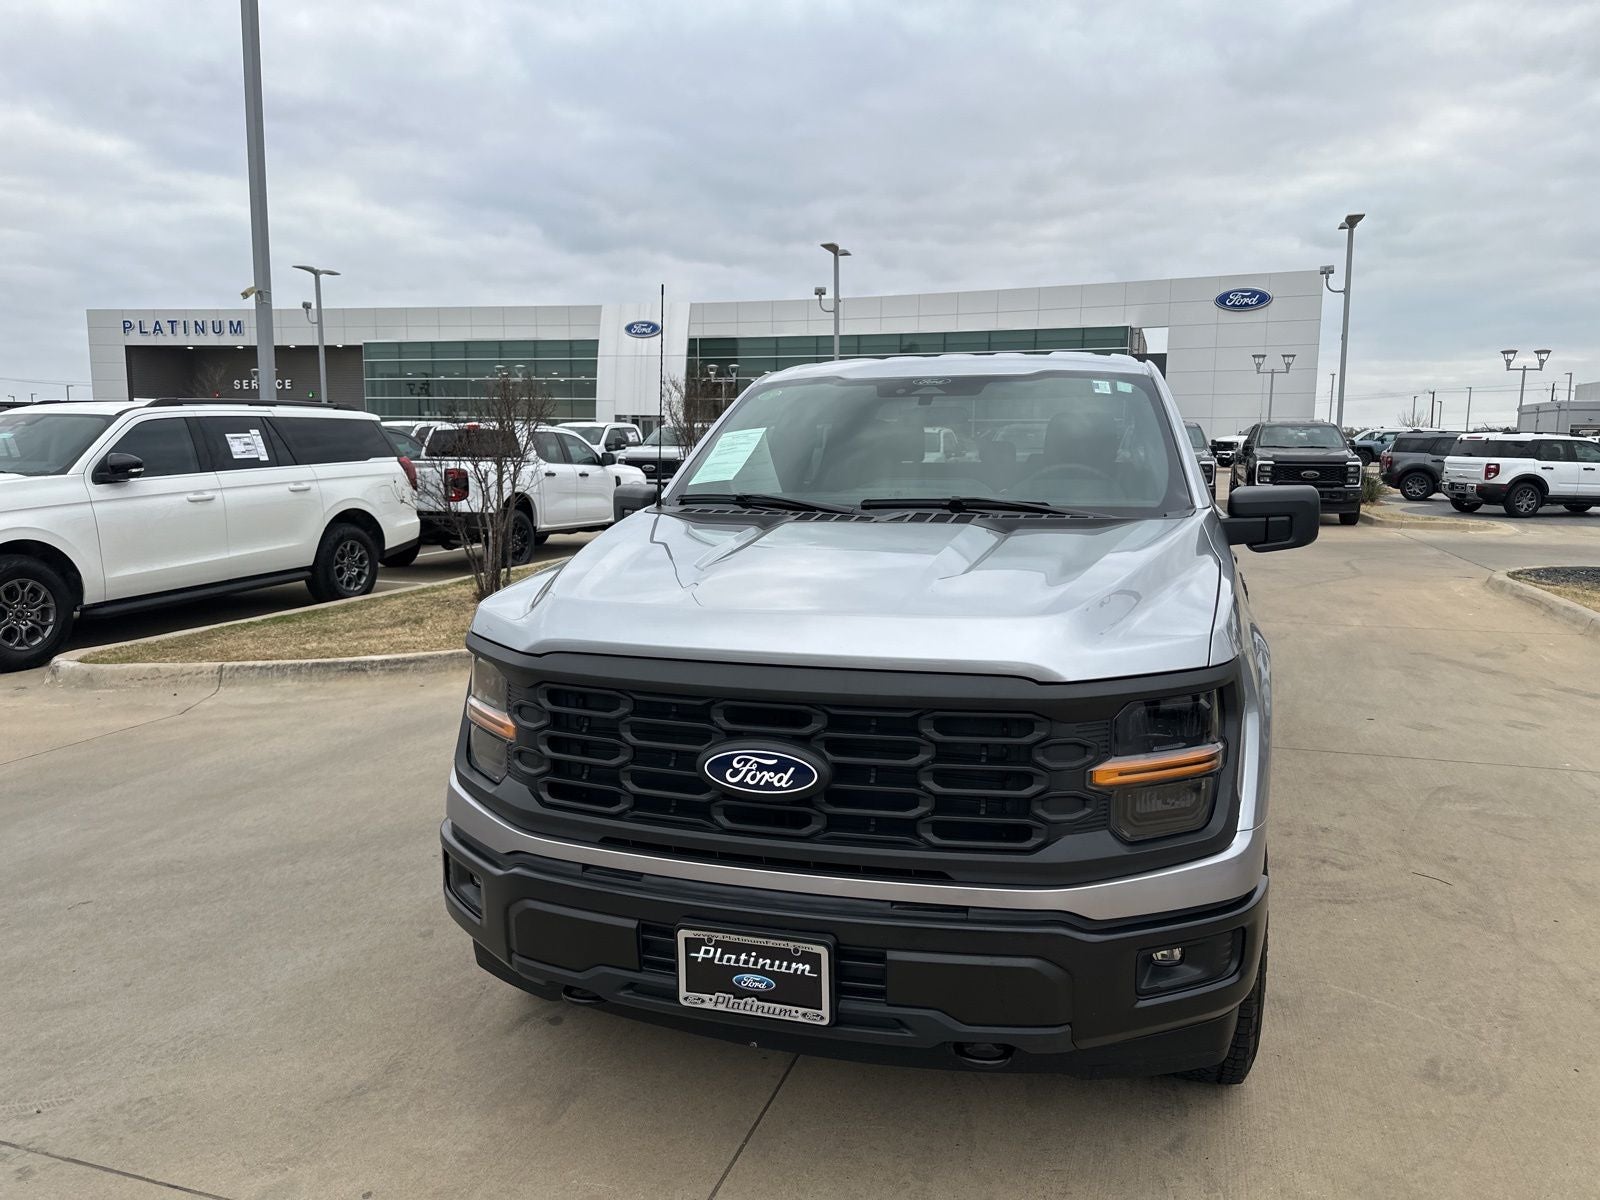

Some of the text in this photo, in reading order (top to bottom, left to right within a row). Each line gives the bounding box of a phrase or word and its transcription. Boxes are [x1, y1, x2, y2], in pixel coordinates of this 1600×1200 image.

[1226, 291, 1259, 305] Ford
[122, 320, 243, 335] PLATINUM
[631, 323, 653, 333] Ford
[233, 379, 292, 390] SERCE
[725, 755, 795, 787] Ford
[692, 932, 814, 951] www.PlatinumFord.com
[689, 945, 818, 977] Platinum
[741, 976, 767, 989] Ford
[713, 995, 800, 1018] Platinum
